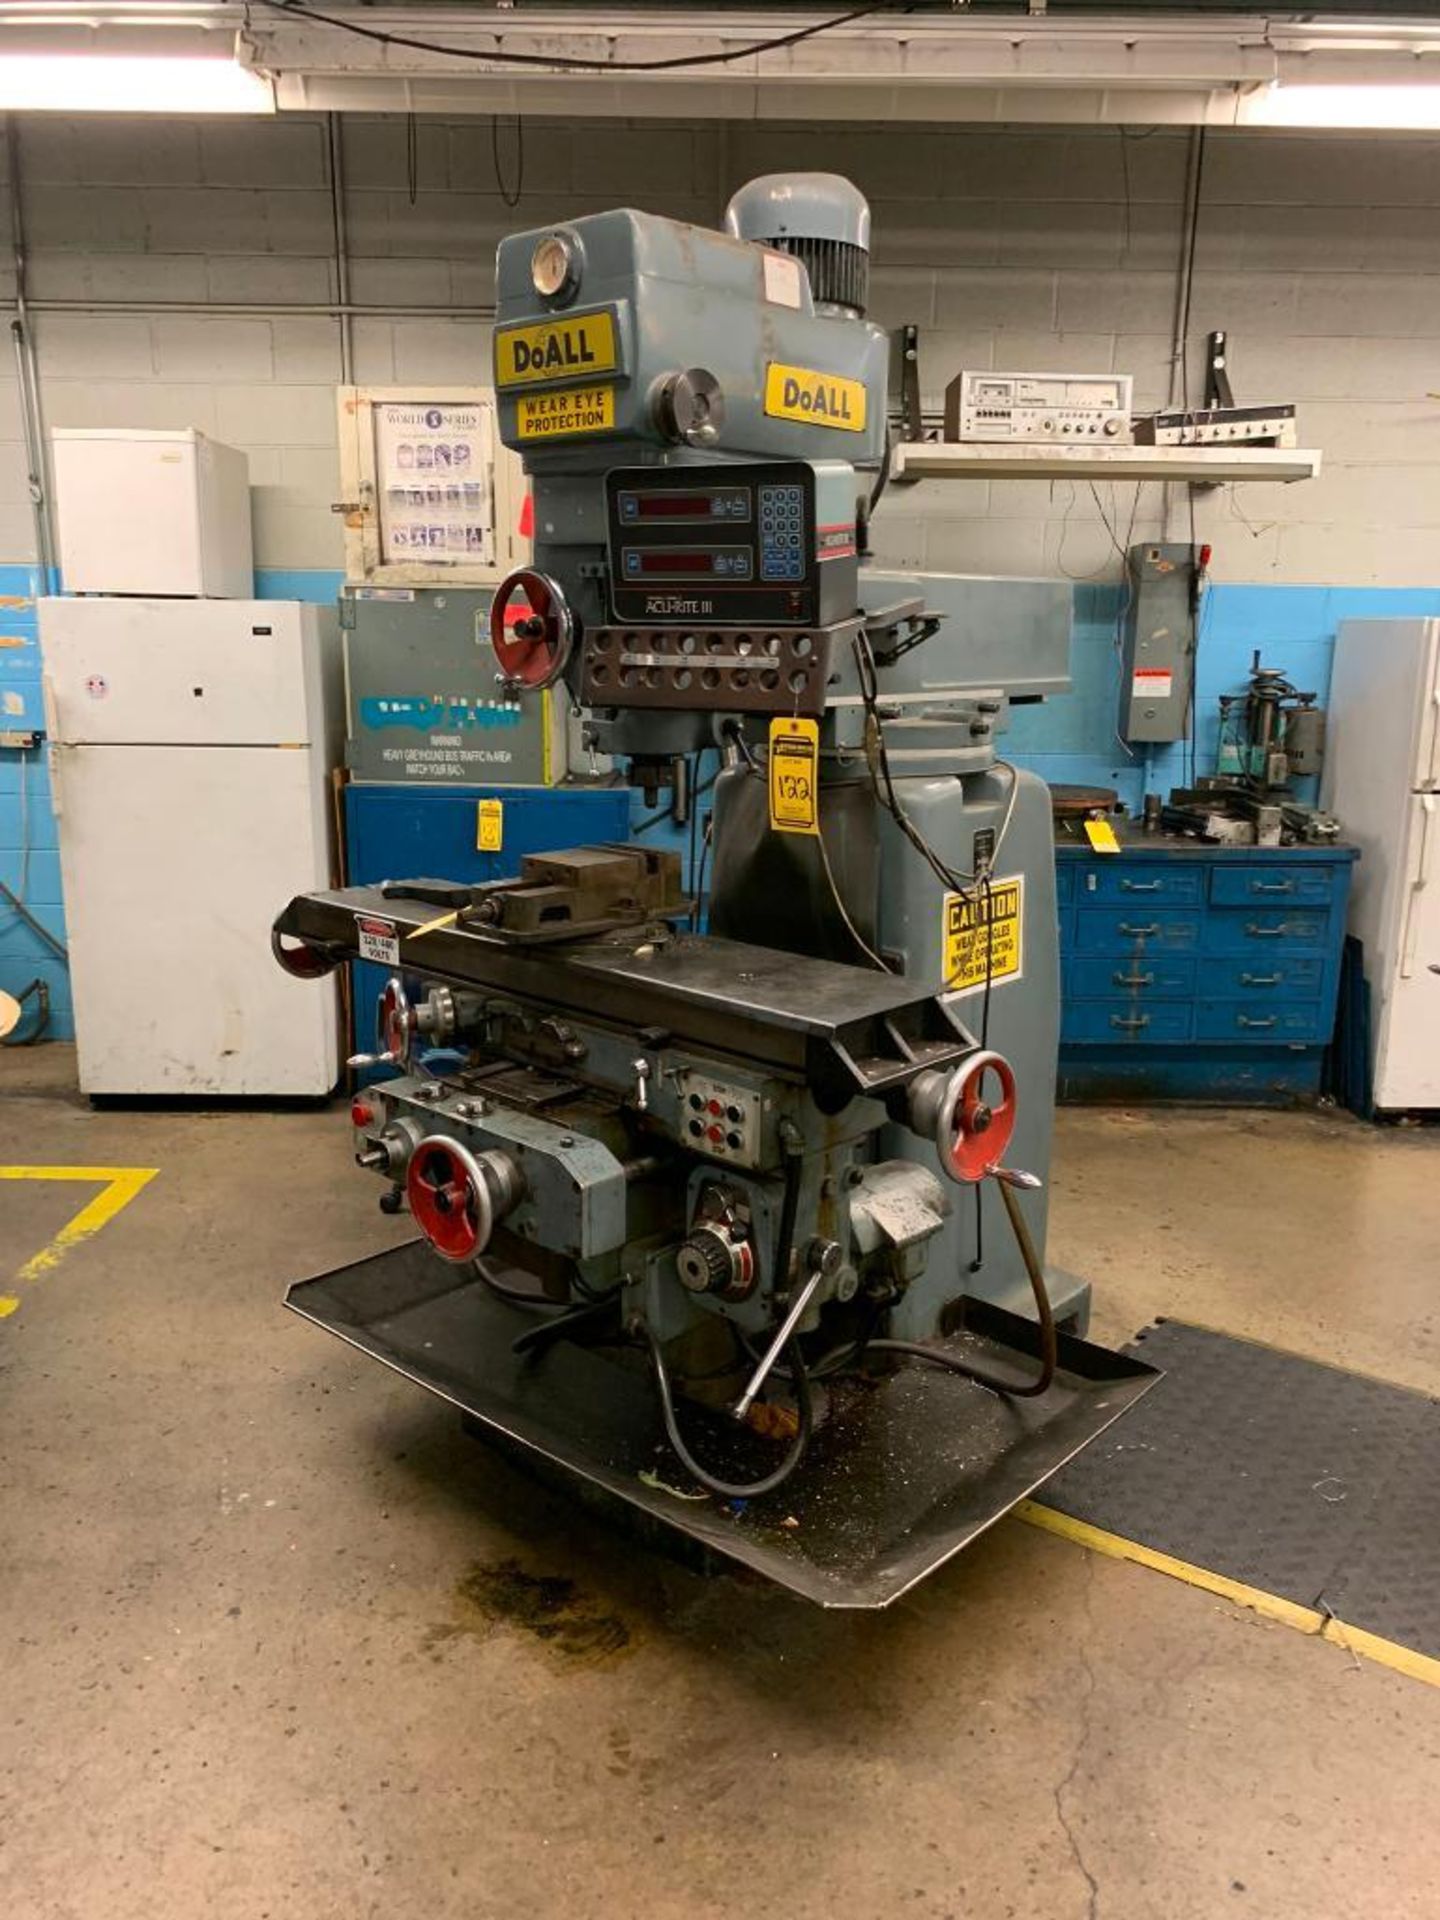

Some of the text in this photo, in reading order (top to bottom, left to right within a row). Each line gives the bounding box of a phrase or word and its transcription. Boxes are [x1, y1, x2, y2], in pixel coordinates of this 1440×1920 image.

[513, 329, 594, 373] DoALL
[525, 391, 604, 416] WEAR EYE
[783, 378, 851, 420] DoALL
[526, 411, 604, 433] PROTECTION
[778, 775, 810, 801] 122
[950, 890, 1017, 931] CAUTION
